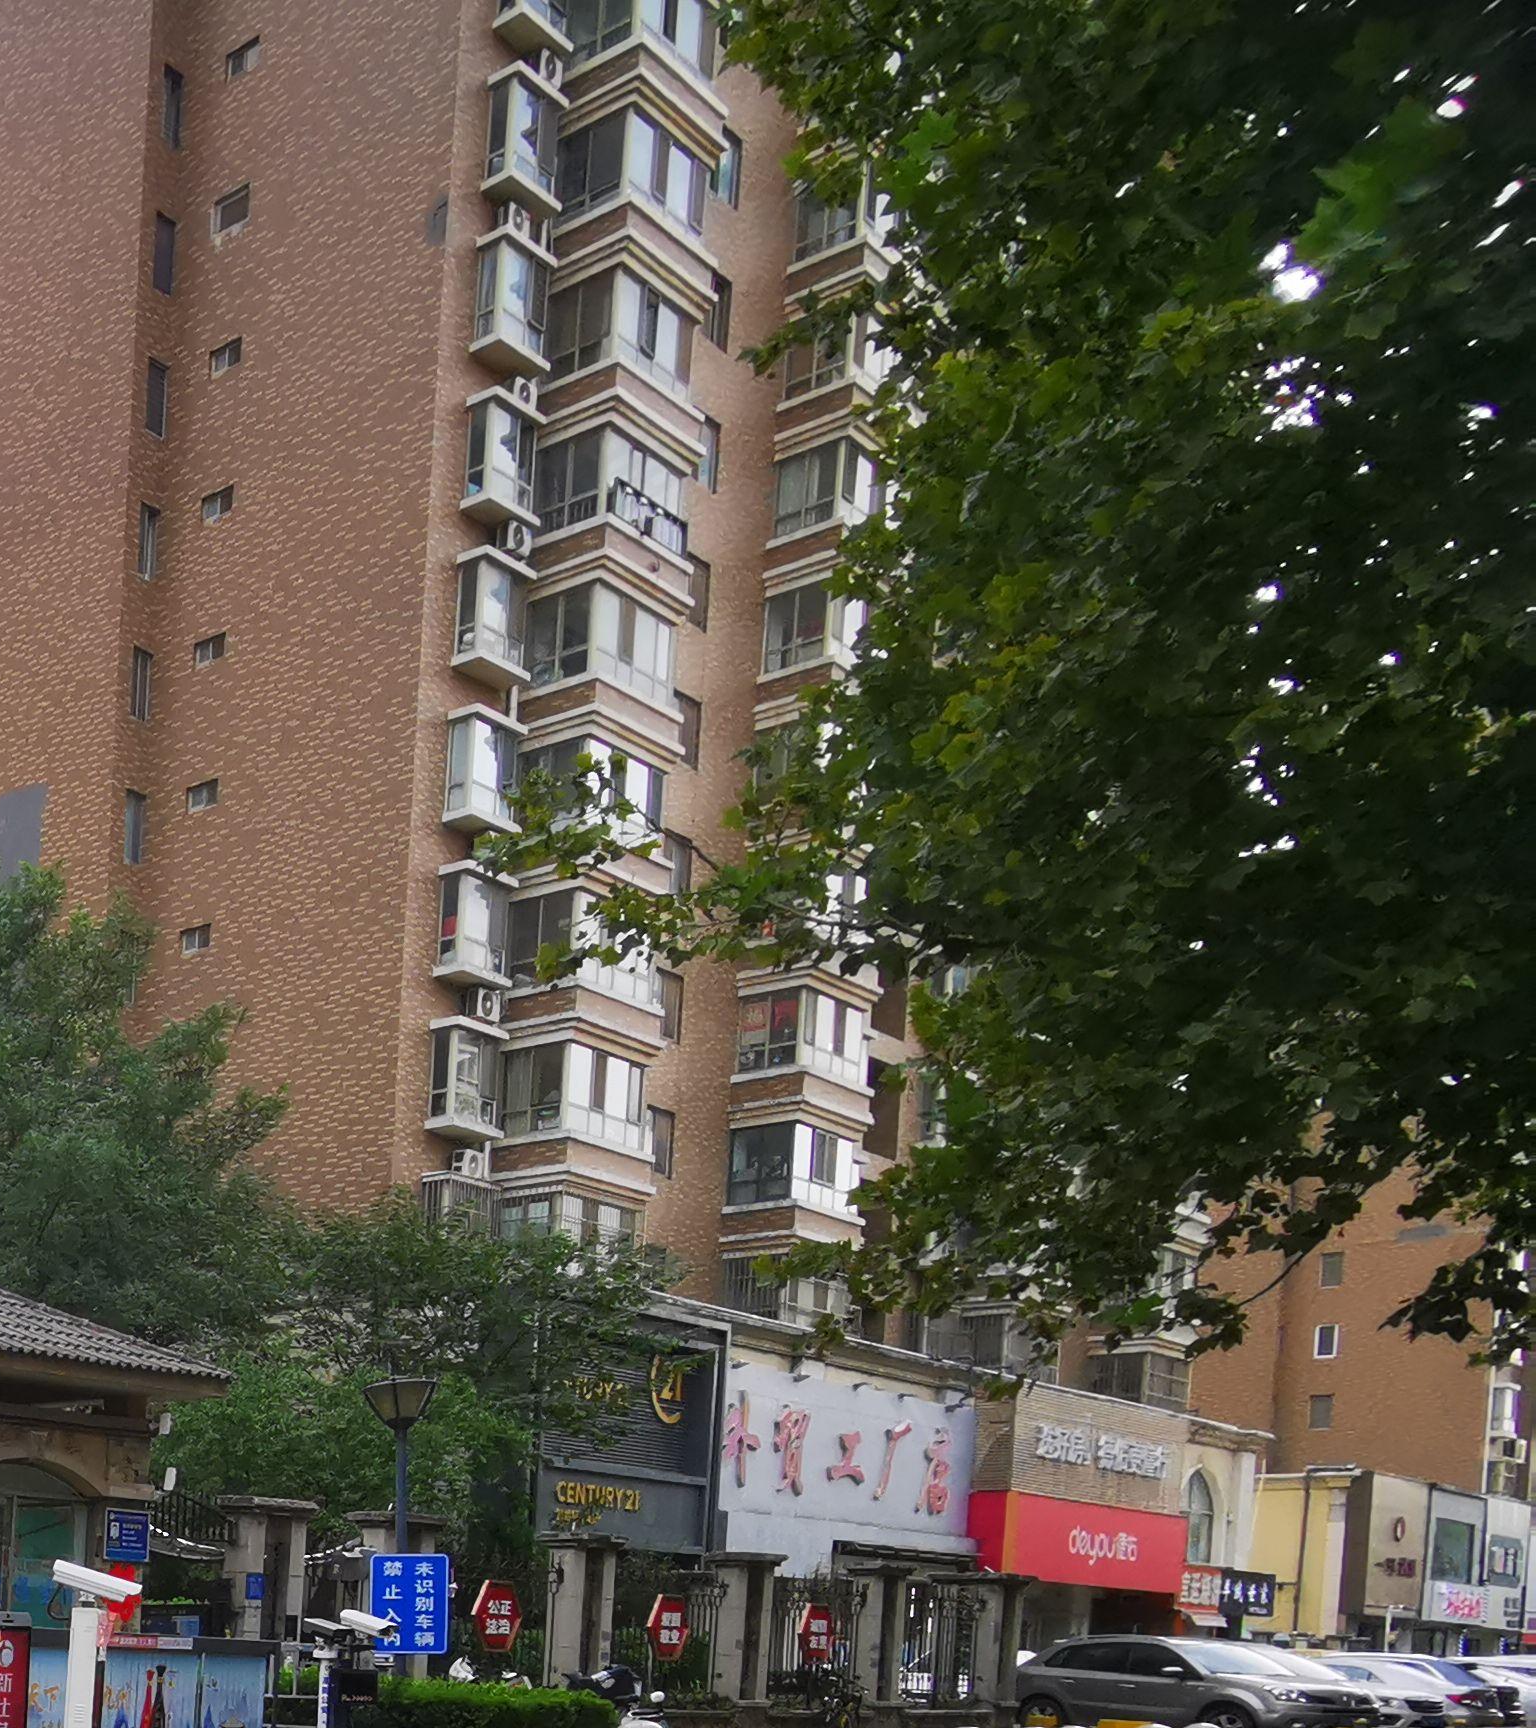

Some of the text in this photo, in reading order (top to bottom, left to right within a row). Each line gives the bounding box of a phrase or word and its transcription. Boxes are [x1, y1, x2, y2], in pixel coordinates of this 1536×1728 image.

[720, 1390, 953, 1516] 外贸工厂店
[556, 1481, 641, 1511] CENTURY 21
[414, 1562, 435, 1646] 未识别车辆
[488, 1600, 512, 1615] 公正
[485, 1619, 510, 1635] 法治
